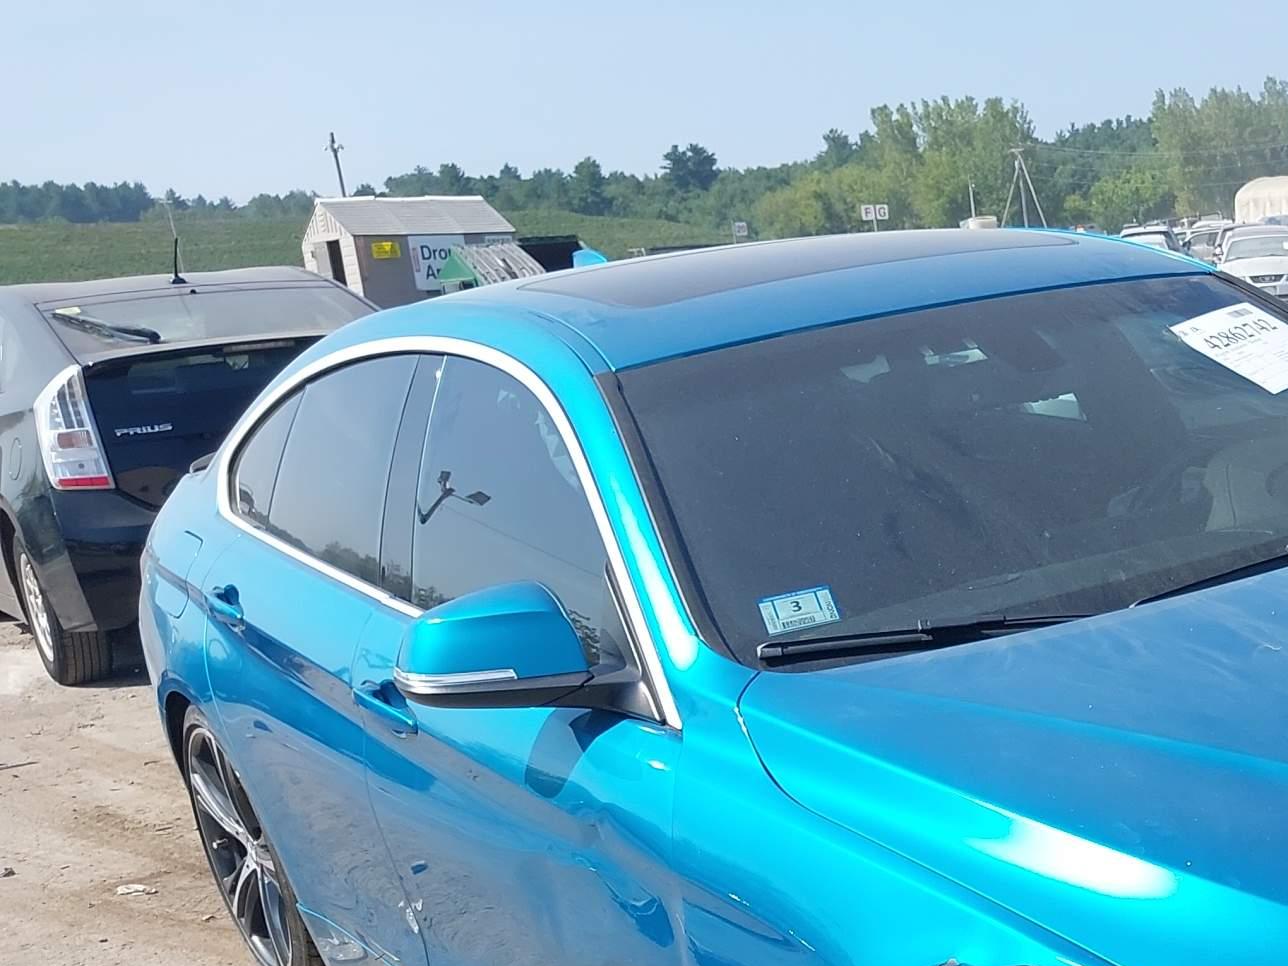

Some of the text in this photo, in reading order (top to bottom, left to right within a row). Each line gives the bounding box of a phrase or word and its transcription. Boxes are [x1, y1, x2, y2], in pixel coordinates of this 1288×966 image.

[1202, 318, 1279, 351] 42862742
[114, 422, 174, 437] PRIUS
[789, 600, 803, 613] 3
